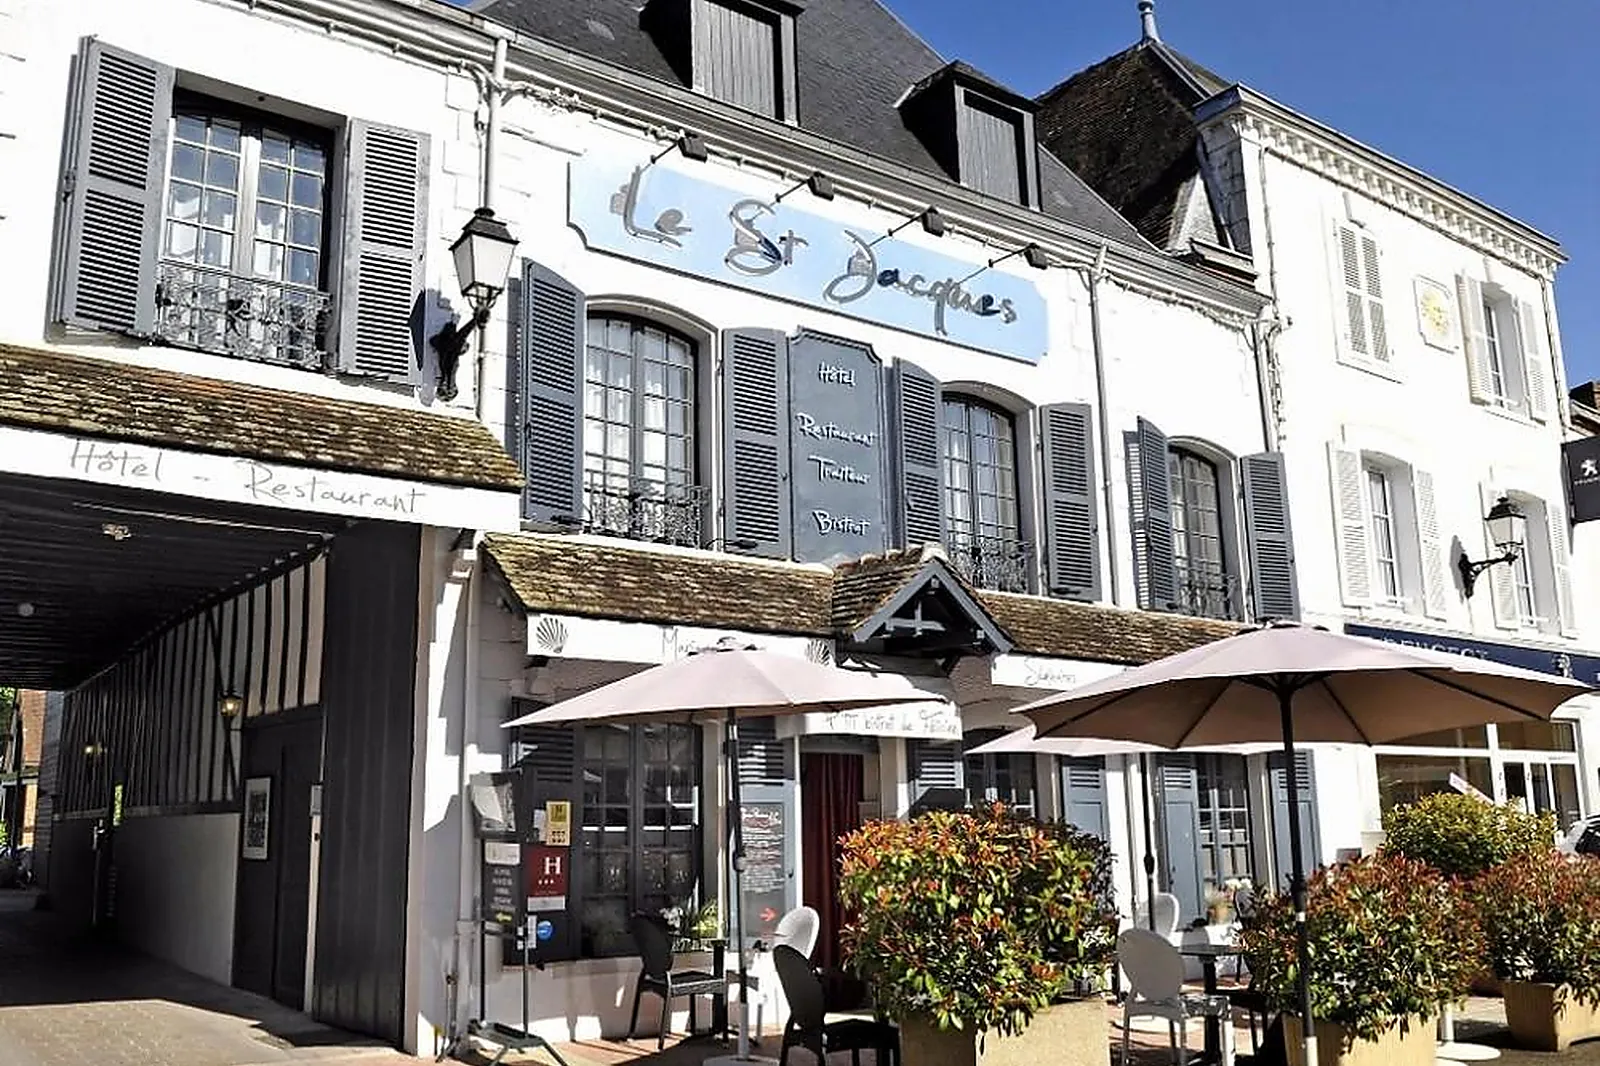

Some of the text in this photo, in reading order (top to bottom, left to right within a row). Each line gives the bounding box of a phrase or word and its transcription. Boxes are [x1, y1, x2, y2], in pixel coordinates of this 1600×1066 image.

[609, 165, 1017, 336] Le St Jacques
[795, 411, 876, 447] Restaurant
[69, 437, 162, 482] Hôtel
[234, 459, 426, 514] Restaurant
[812, 509, 871, 536] Bistrot
[544, 856, 561, 875] H
